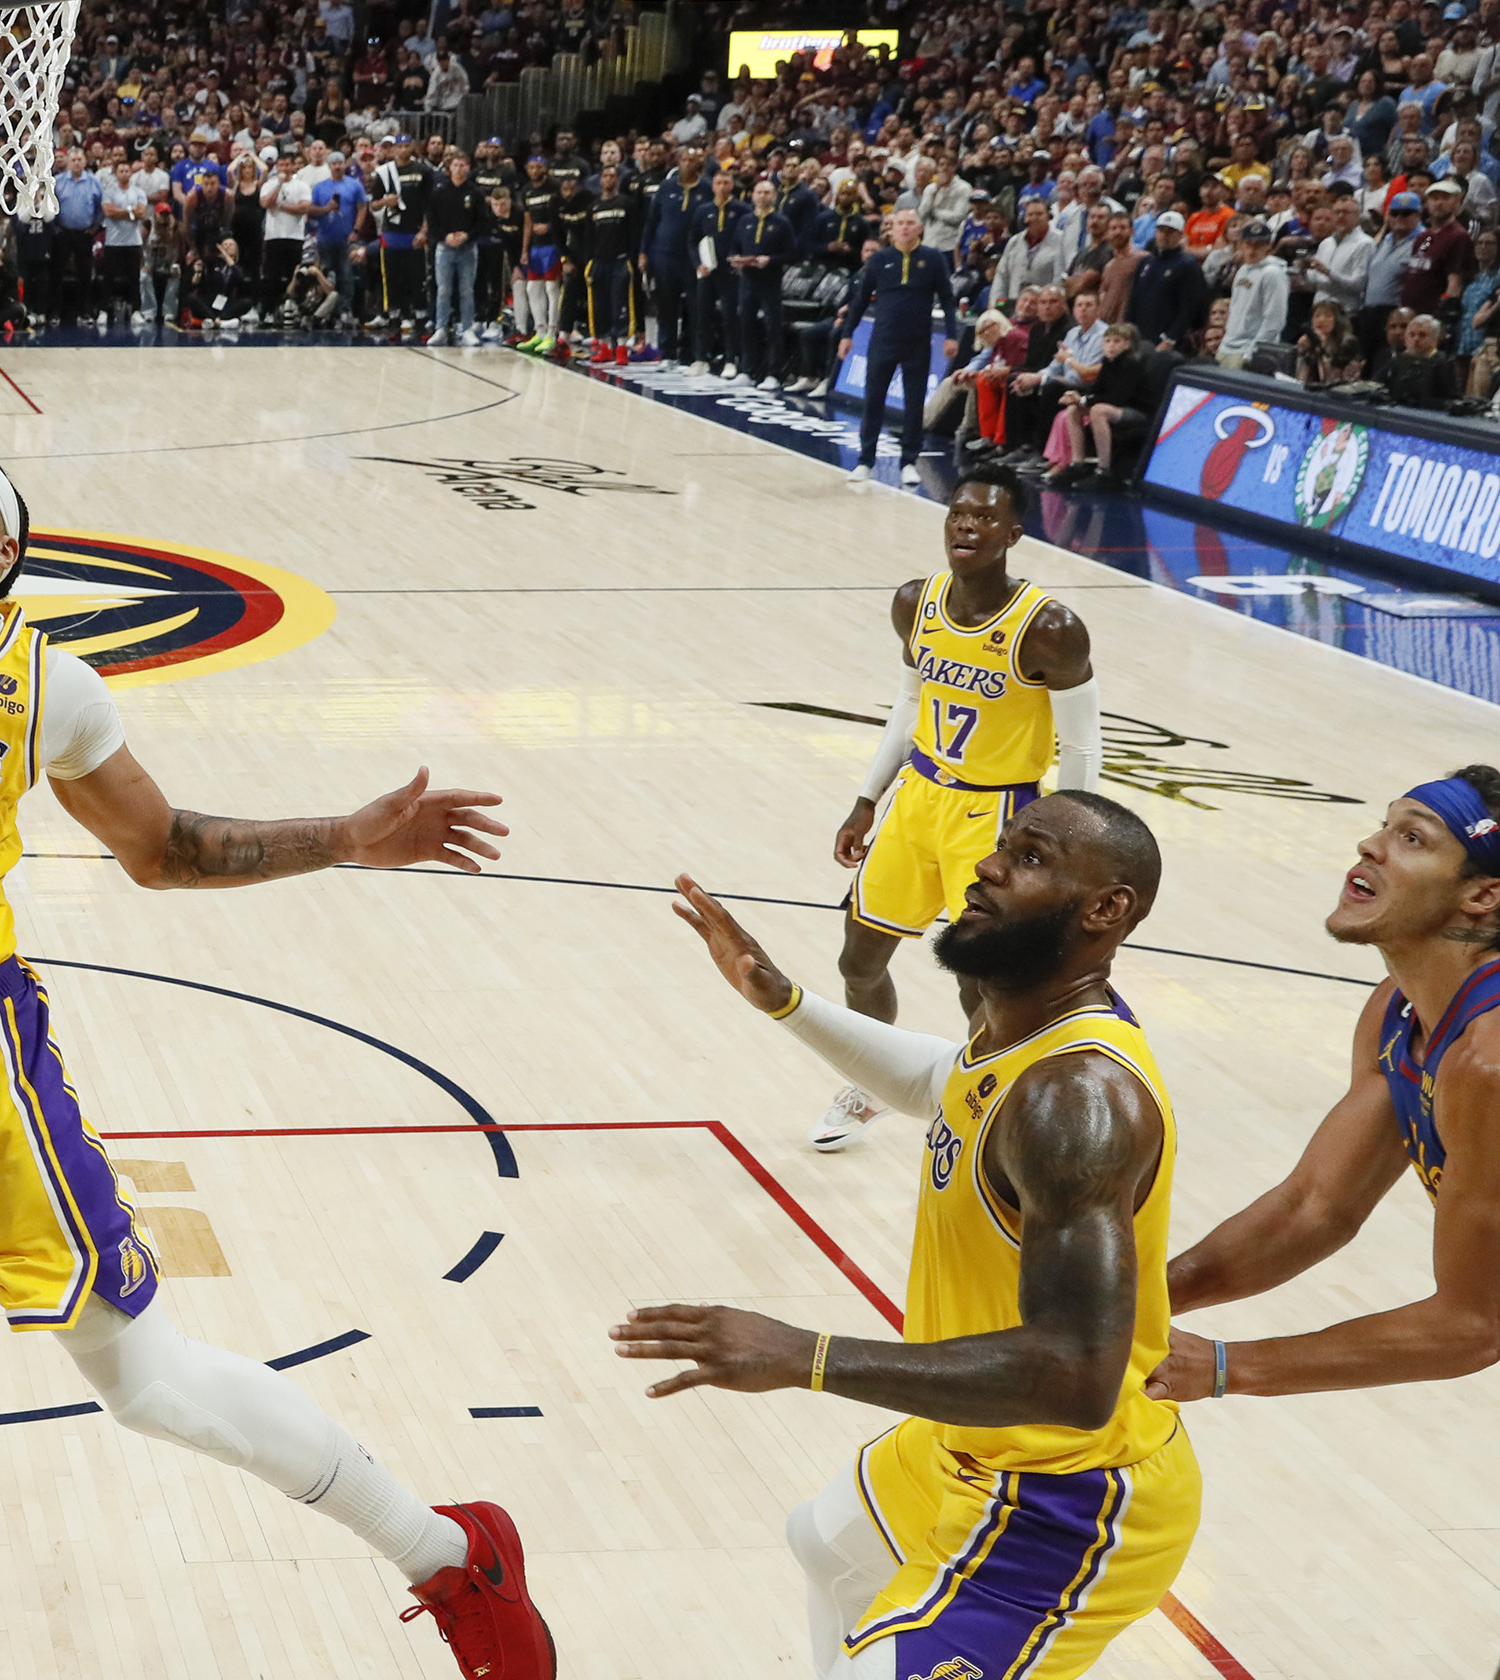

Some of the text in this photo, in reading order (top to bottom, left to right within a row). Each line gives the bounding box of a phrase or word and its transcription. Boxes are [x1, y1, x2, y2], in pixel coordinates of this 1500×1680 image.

[1368, 451, 1500, 560] TOMORRO
[915, 645, 1008, 699] LAKERS
[982, 643, 1008, 656] bibigo
[931, 697, 980, 765] 17
